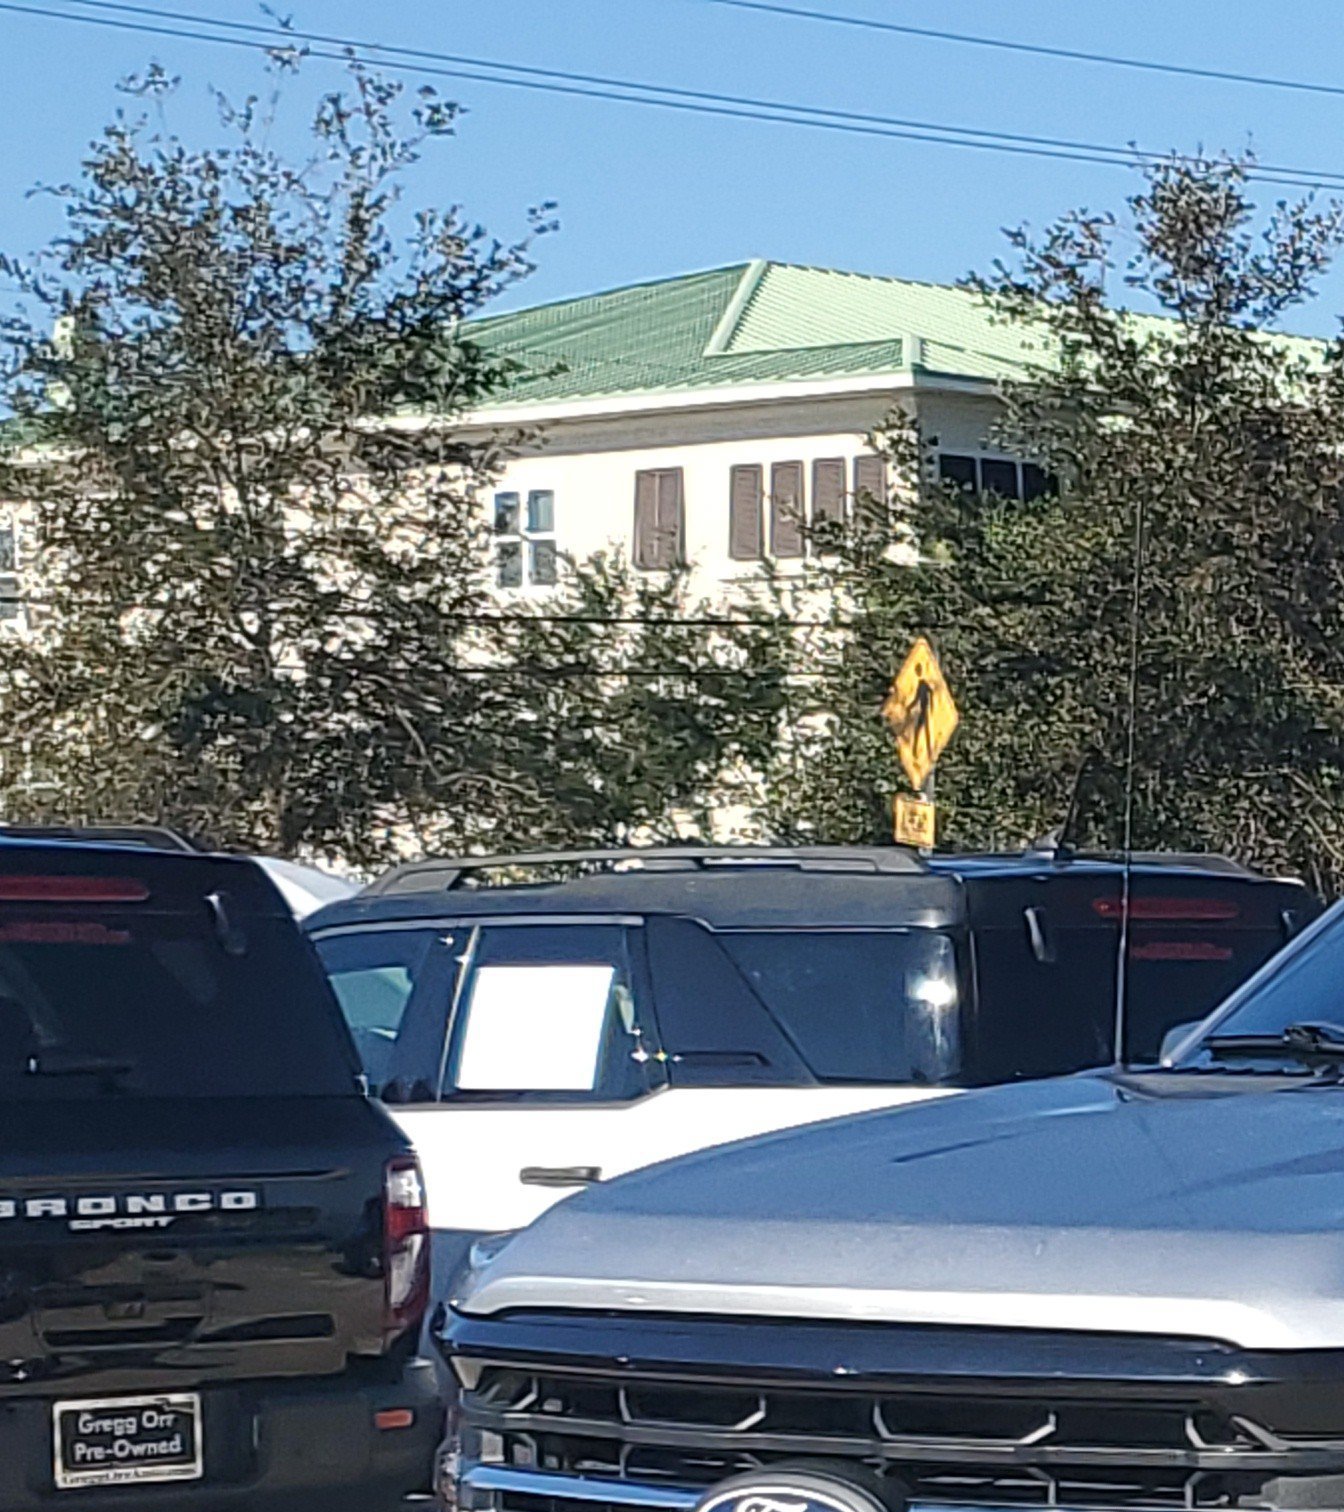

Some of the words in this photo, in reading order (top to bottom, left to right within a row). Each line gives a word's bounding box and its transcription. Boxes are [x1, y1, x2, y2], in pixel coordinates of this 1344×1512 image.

[68, 1216, 176, 1231] SPORT
[78, 1412, 137, 1436] Gregg
[141, 1411, 175, 1428] Orr
[74, 1433, 182, 1462] Pre-Owned
